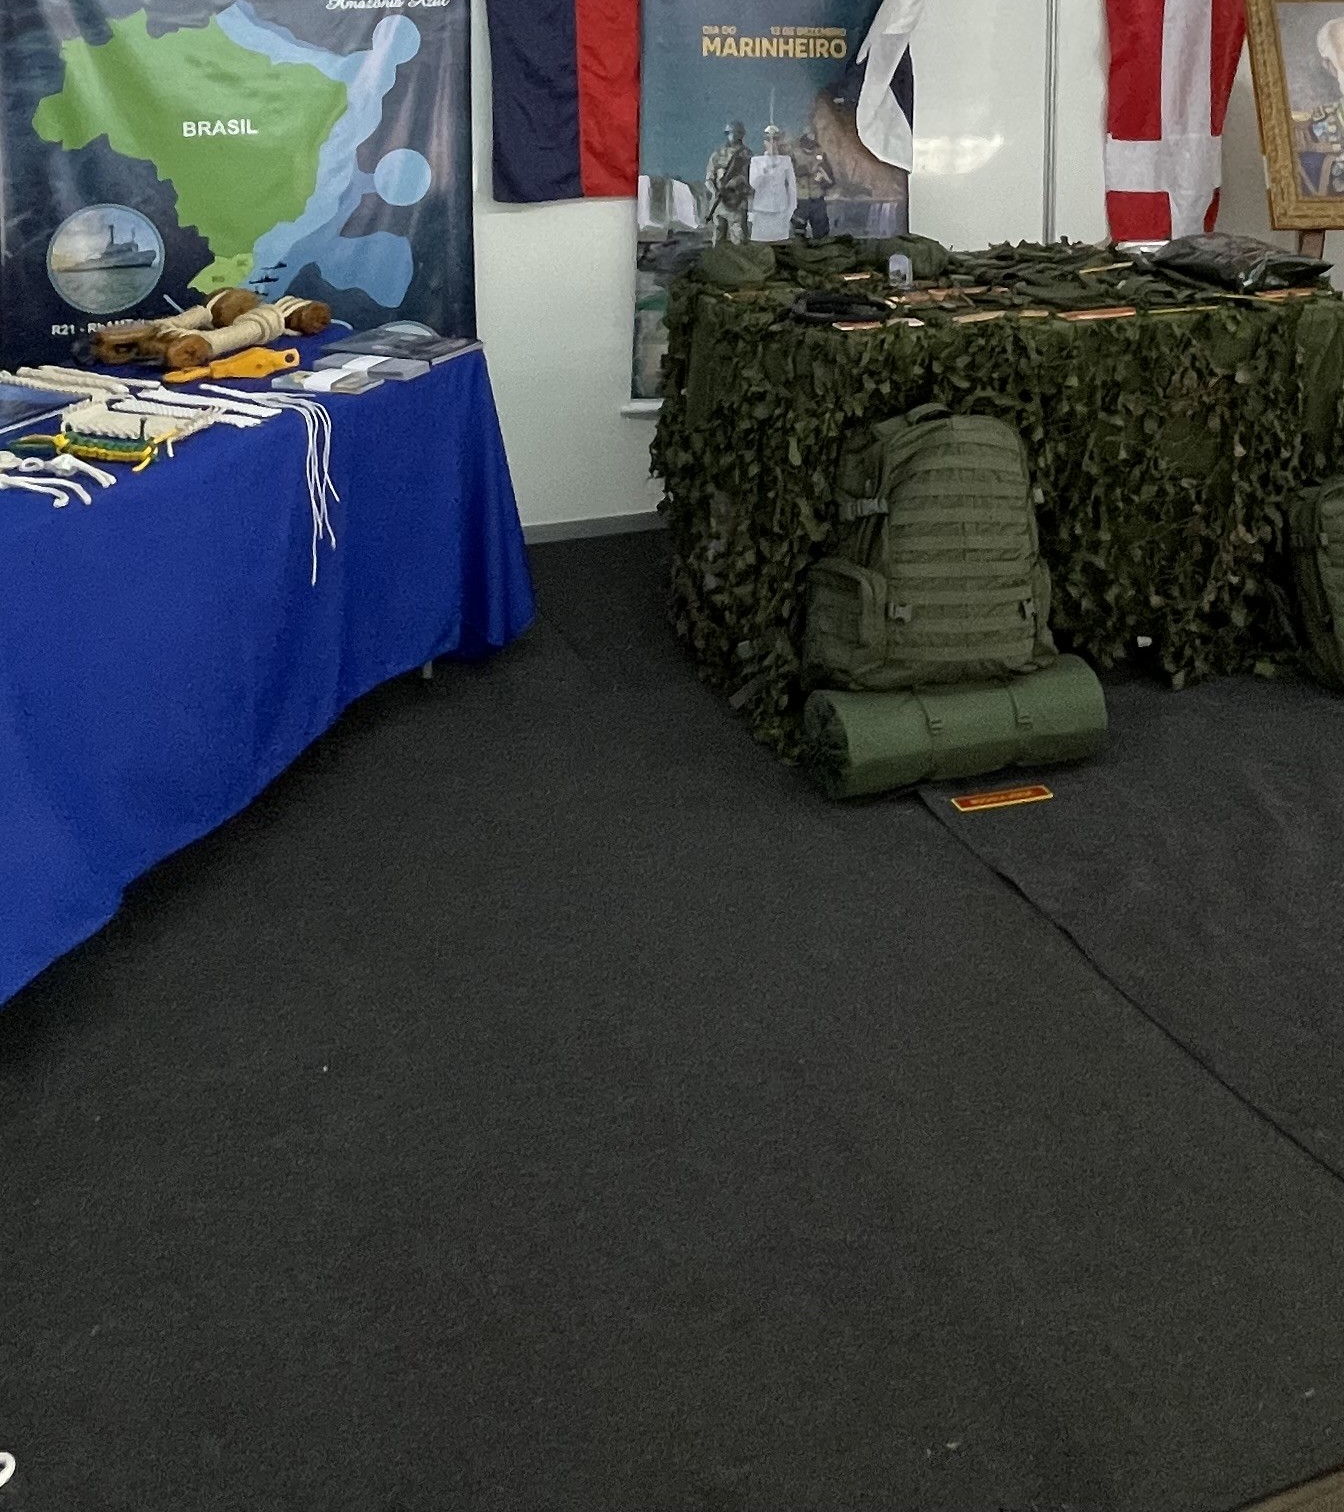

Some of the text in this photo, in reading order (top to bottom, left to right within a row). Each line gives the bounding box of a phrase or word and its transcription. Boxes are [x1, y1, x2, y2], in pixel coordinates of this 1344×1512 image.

[702, 36, 848, 58] MARINHEIRO
[182, 118, 259, 138] BRASIL
[51, 323, 75, 336] R21
